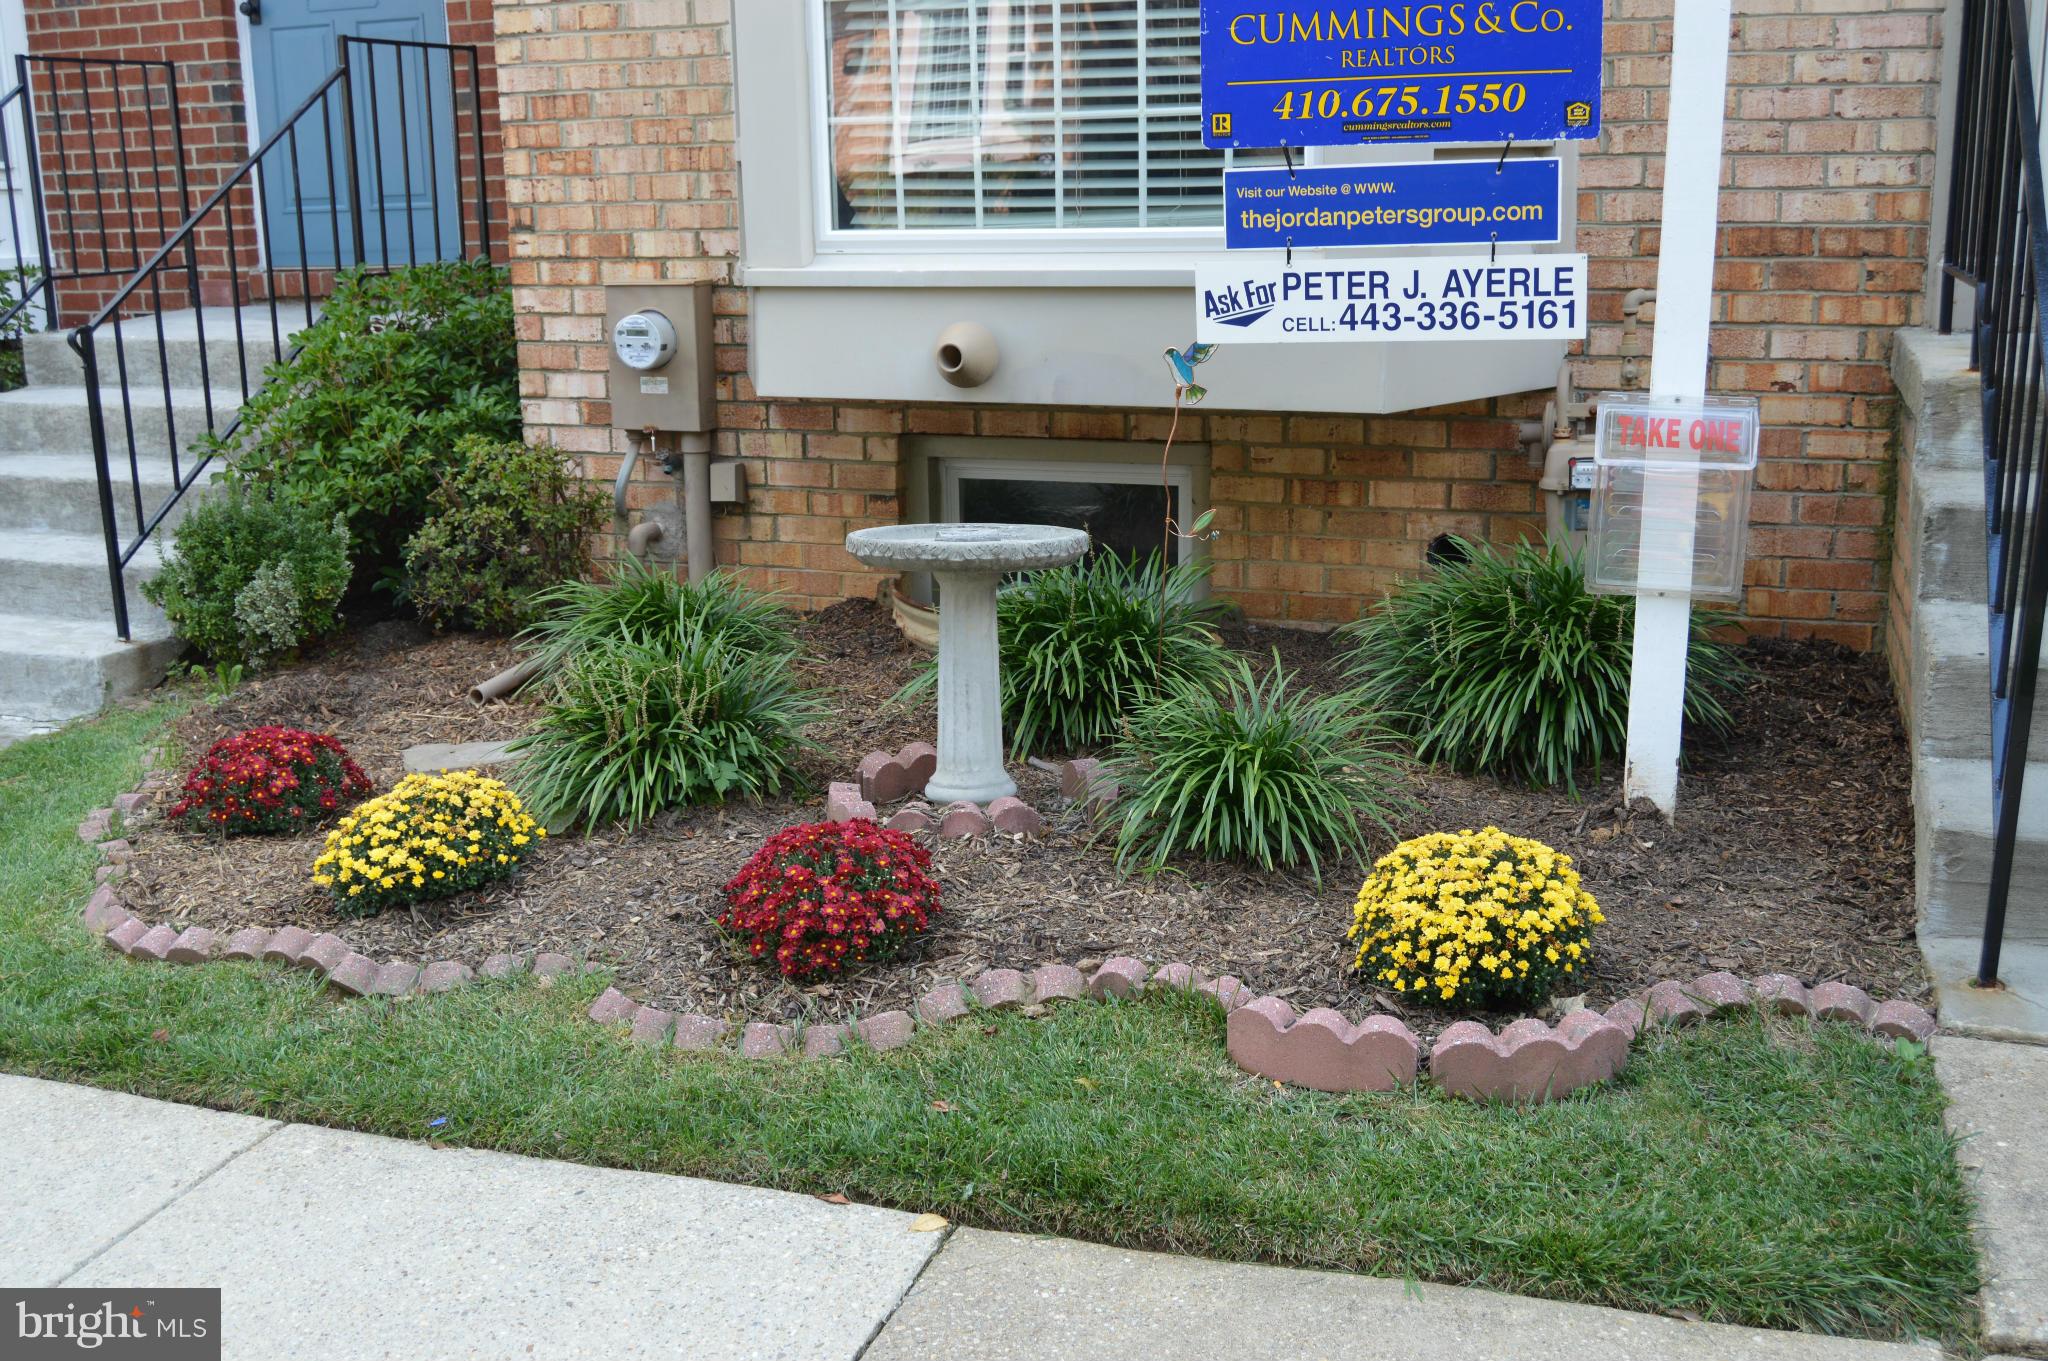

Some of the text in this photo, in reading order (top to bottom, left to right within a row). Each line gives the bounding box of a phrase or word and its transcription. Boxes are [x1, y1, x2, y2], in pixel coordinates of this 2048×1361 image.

[1230, 4, 1466, 45] CUMMINGS
[1341, 45, 1456, 68] REALTORS
[1272, 82, 1526, 120] 410.675.1550
[1343, 120, 1452, 131] cummingsrealtors.com
[1236, 182, 1396, 198] Visit our Website @ WWW.
[1240, 204, 1543, 233] thejordanpetersgroup.com
[1204, 279, 1277, 318] Ask For
[1282, 266, 1575, 301] PETER J. AYERLE
[1282, 299, 1576, 332] CELL: 443-336-5161
[1617, 415, 1743, 452] TAKE ONE
